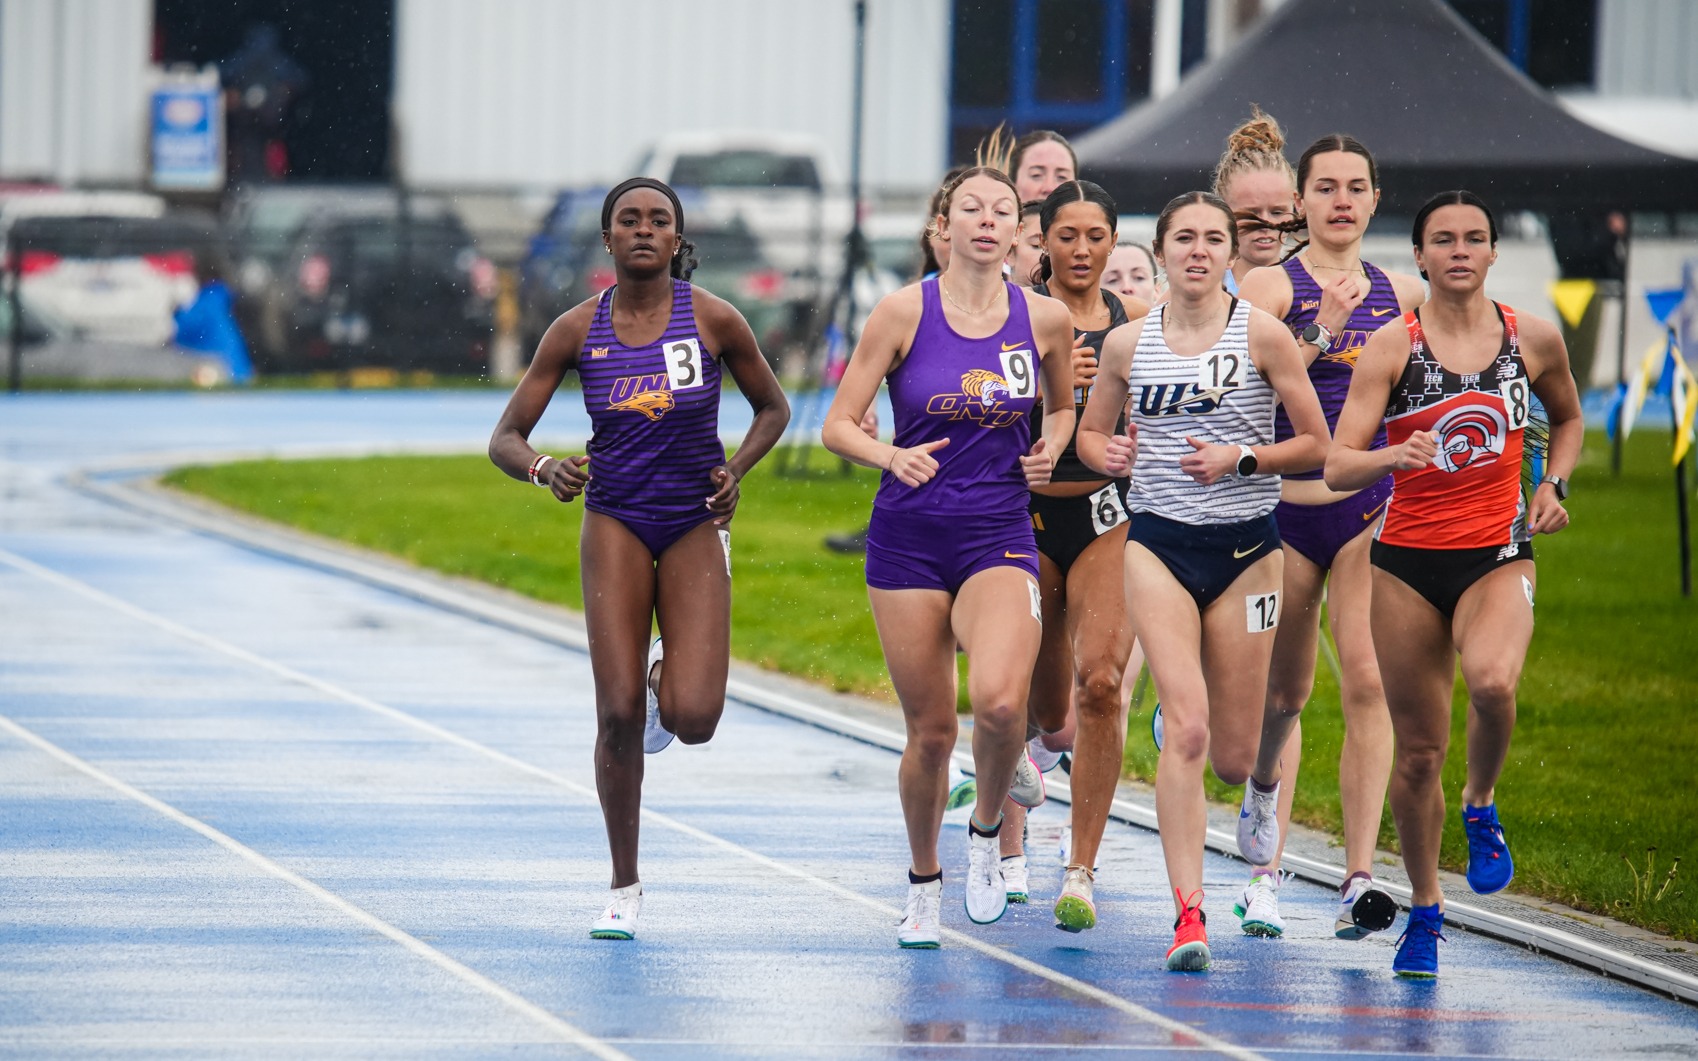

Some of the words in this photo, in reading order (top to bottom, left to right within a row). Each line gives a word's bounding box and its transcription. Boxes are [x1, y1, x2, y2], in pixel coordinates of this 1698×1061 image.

[671, 342, 696, 387] 3
[1008, 353, 1030, 396] 9
[1207, 353, 1239, 388] 12
[1424, 374, 1443, 383] TECH
[1461, 373, 1480, 382] TECH
[926, 393, 1025, 429] ONU
[1139, 383, 1217, 417] UIS
[1509, 381, 1526, 427] 8
[1097, 489, 1118, 527] 6
[1254, 594, 1277, 630] 12
